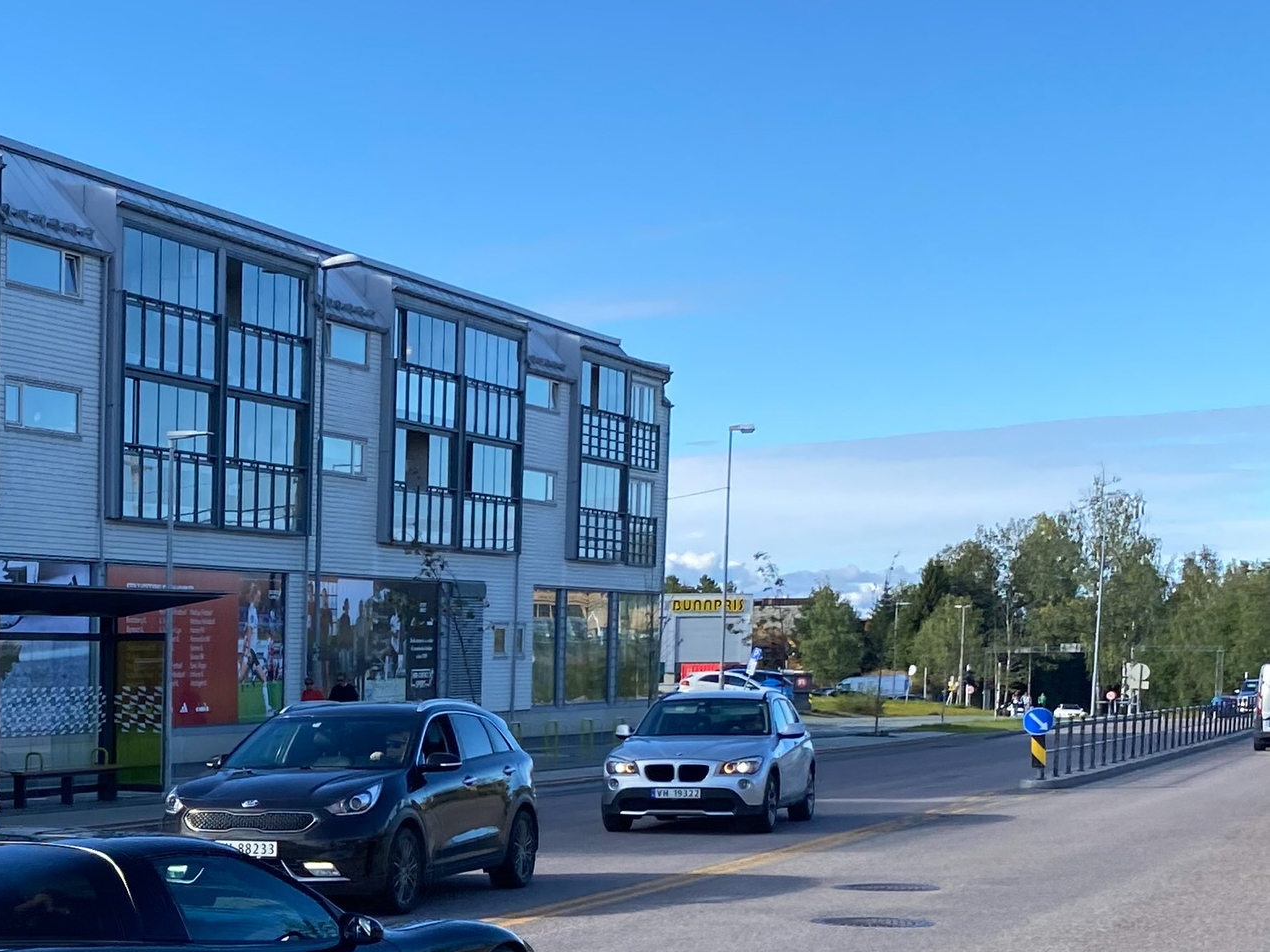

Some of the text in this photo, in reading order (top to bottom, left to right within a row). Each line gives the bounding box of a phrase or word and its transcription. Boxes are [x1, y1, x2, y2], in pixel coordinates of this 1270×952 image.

[656, 789, 699, 798] VH 19322
[238, 842, 275, 855] 88233
